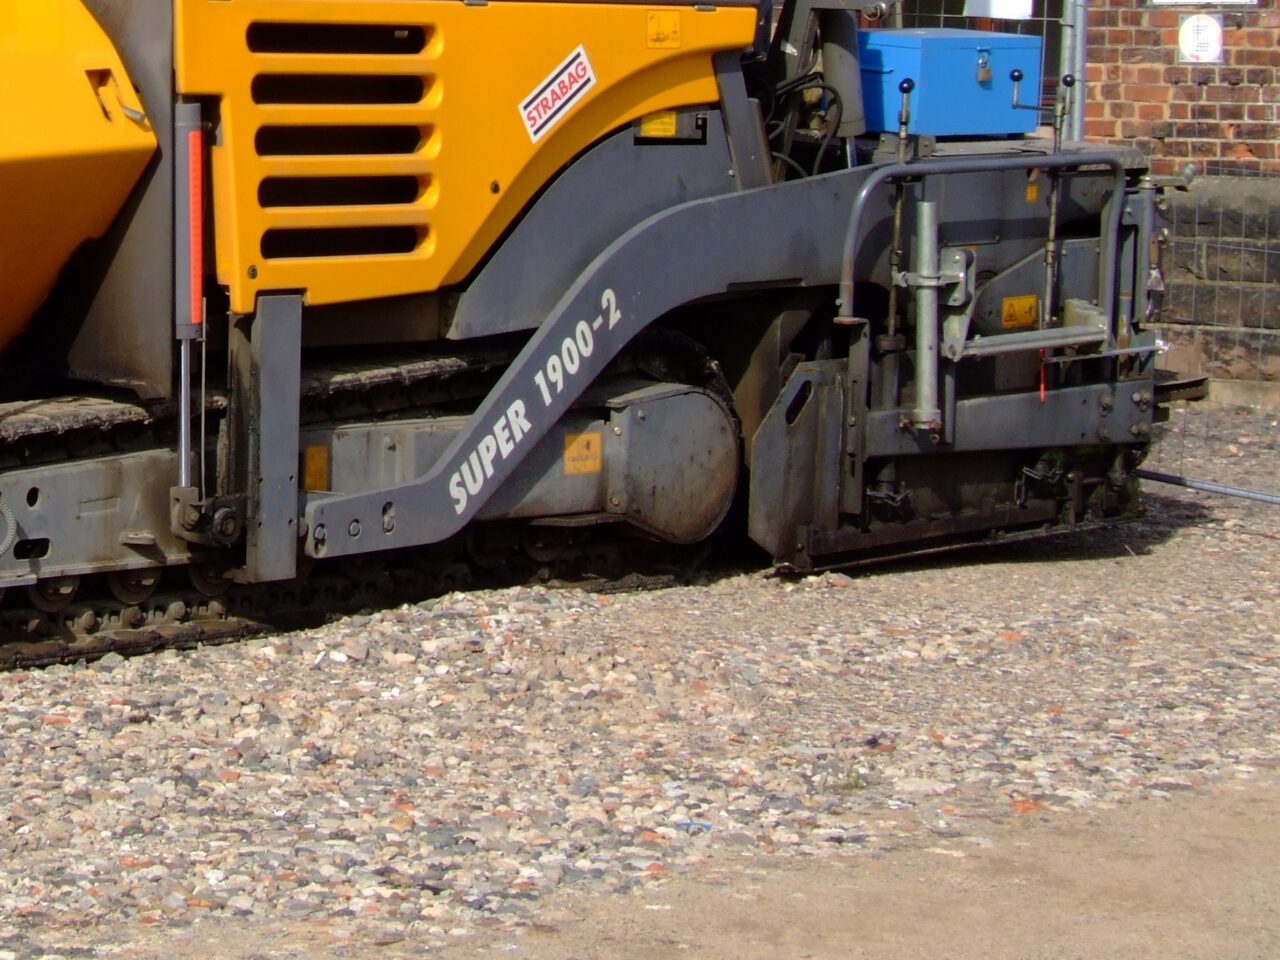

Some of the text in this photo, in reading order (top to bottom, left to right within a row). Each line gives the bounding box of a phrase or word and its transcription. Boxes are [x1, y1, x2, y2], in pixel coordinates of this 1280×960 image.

[525, 60, 588, 129] STRABAG
[449, 288, 622, 515] SUPER 1900-2
